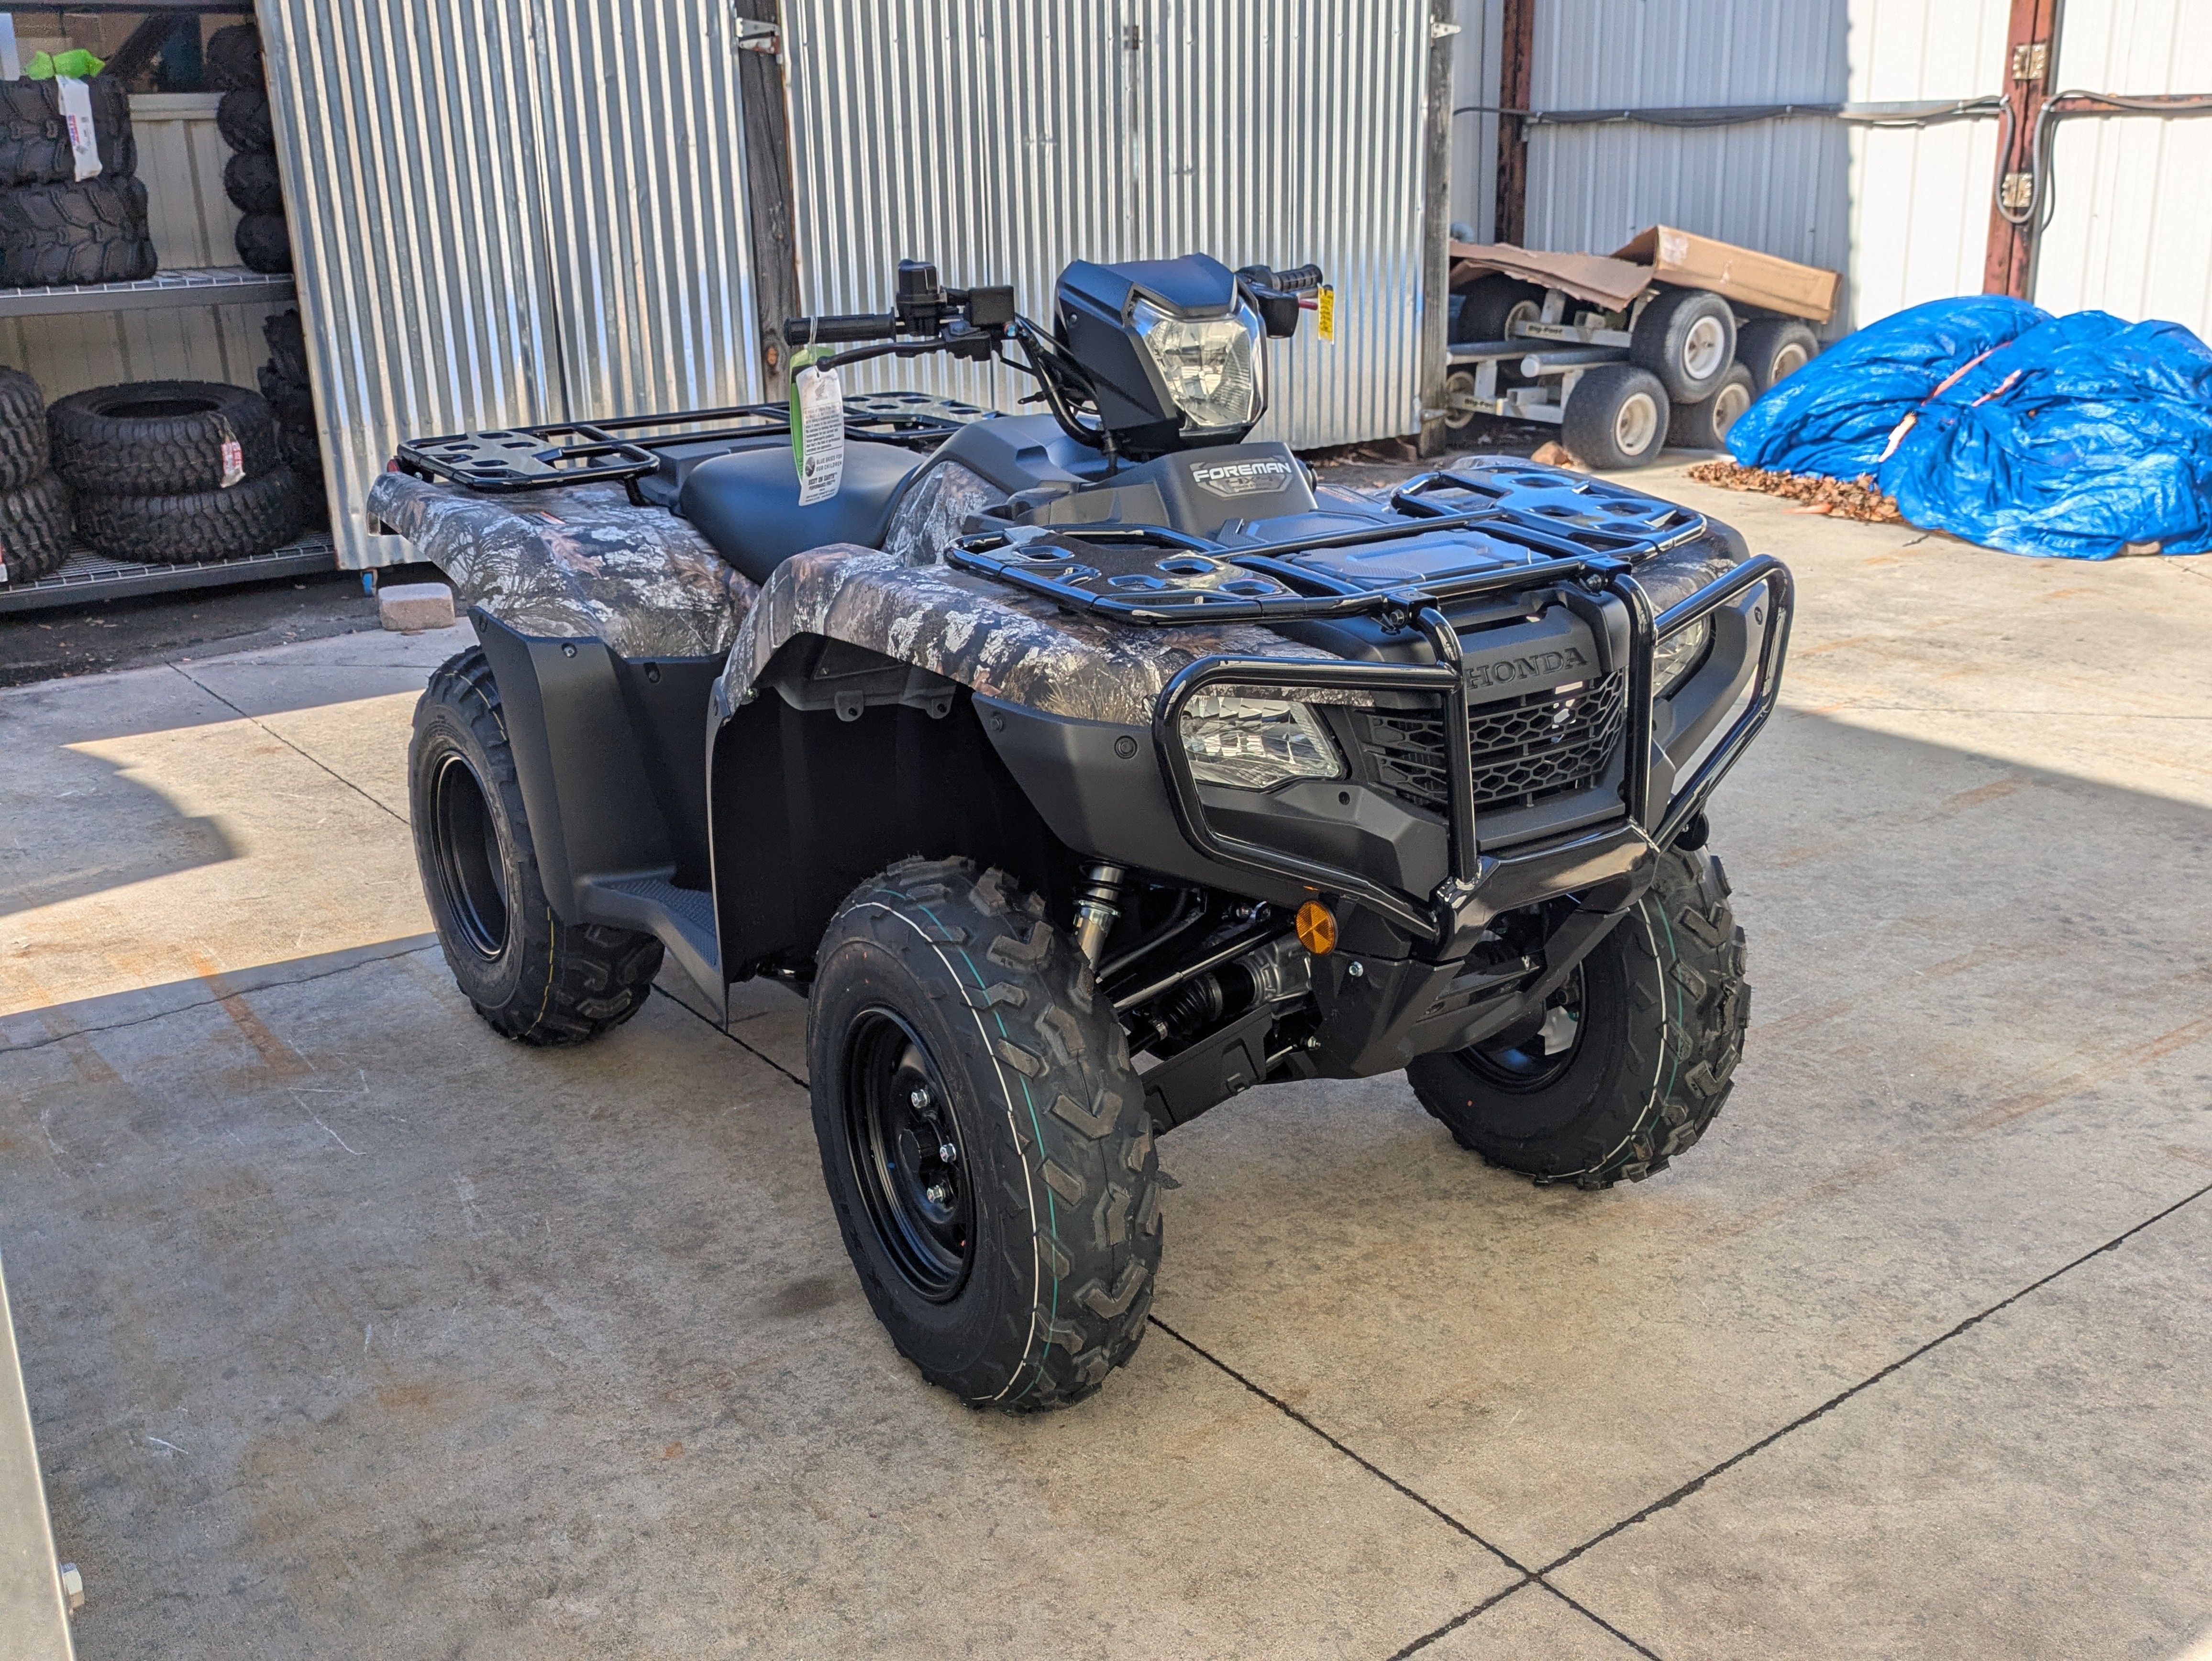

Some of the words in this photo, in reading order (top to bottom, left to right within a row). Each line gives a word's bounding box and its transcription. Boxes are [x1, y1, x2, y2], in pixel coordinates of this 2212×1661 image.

[824, 461, 841, 469] CHILDREN
[1193, 463, 1292, 482] FOREMAN
[1465, 647, 1588, 689] HONDA
